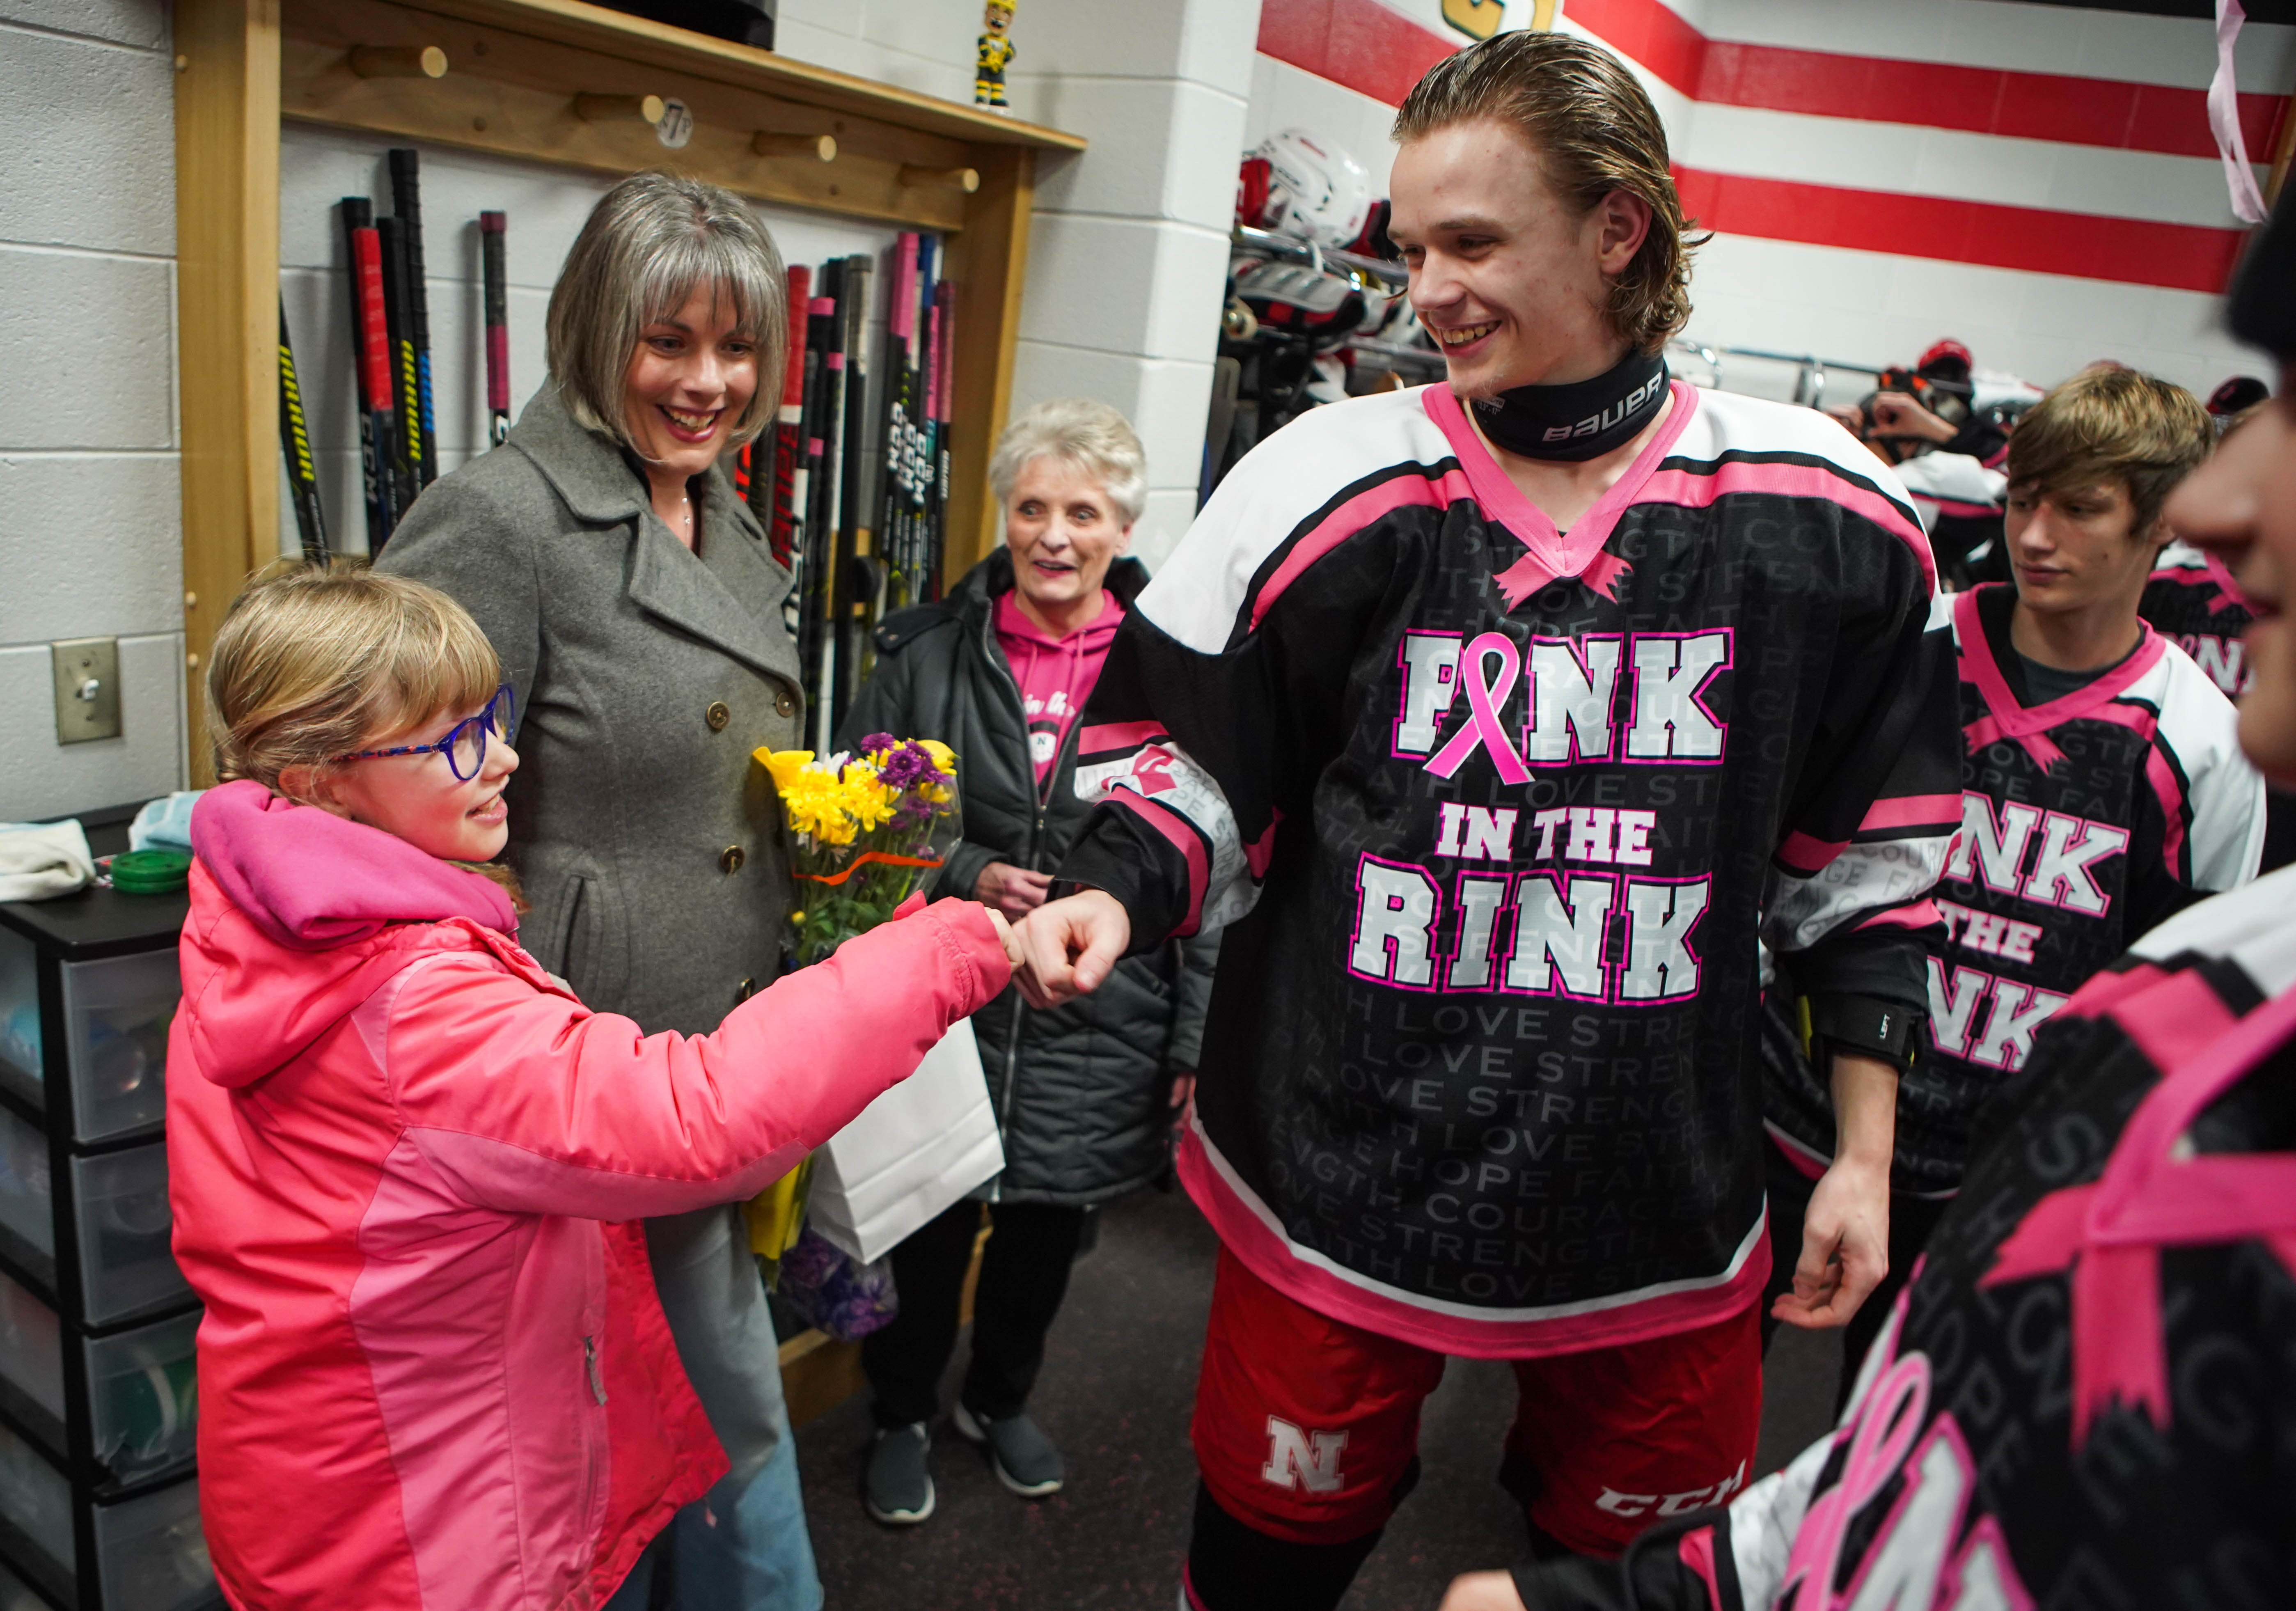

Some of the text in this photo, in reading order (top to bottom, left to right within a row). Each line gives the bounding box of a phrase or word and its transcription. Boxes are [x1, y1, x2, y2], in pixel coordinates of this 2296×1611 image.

[1542, 371, 1662, 442] BAUER
[360, 411, 379, 504] CCM
[912, 432, 926, 505] CCM
[1489, 774, 1625, 808] LOVE
[1434, 800, 1519, 862] IN
[1533, 805, 1657, 866] THE
[1947, 788, 2131, 919] NK
[1346, 850, 1712, 1006] RINK
[1936, 897, 2044, 965] THE
[1396, 1000, 1550, 1040] LOVE
[1927, 954, 2072, 1073] NK
[1363, 1032, 1513, 1079] LOVE
[1340, 1061, 1686, 1125] OVE STRENG
[1391, 1150, 1551, 1198] HOPE
[1445, 1123, 1595, 1162] LOVE
[1426, 1263, 1573, 1300] LOVE
[1261, 1414, 1350, 1494] N
[1595, 1457, 1747, 1517] CCM
